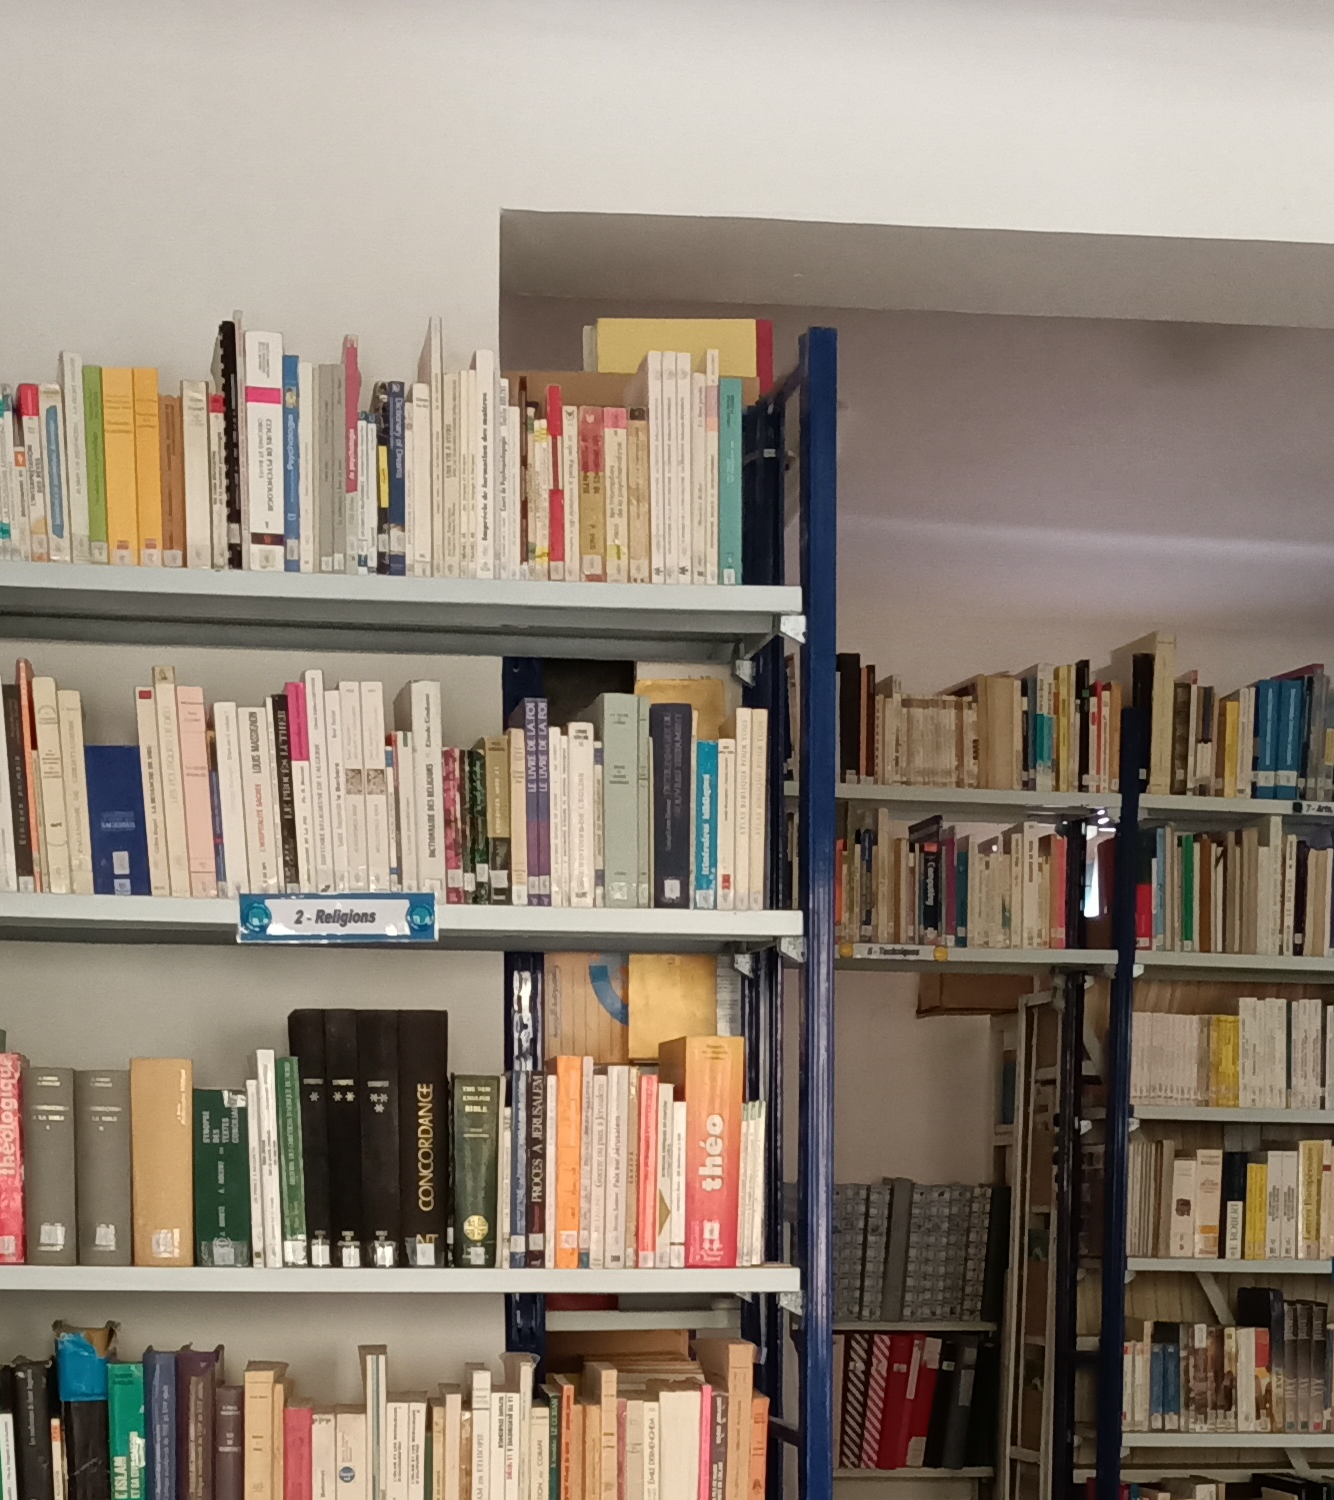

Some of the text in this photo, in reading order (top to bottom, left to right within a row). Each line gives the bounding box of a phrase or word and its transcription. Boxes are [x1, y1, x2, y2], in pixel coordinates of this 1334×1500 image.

[286, 414, 294, 470] Psychologie
[395, 398, 404, 436] Dictionary
[248, 712, 261, 773] LOUIS MASSIGNON
[525, 702, 537, 793] LE LIVRE DE LA FOI
[538, 702, 548, 792] LE LIVRE DE LA FOI
[426, 763, 437, 858] DICTIONNAIRE DES RELIGIONS
[294, 910, 376, 927] 2 Religions
[465, 1105, 488, 1113] BIBLE
[532, 1076, 543, 1140] JERUSALEM
[417, 1083, 434, 1211] CONCORDANCE
[699, 1113, 724, 1192] théo
[114, 1456, 128, 1499] L'ISLAM
[536, 1440, 544, 1466] CORAN
